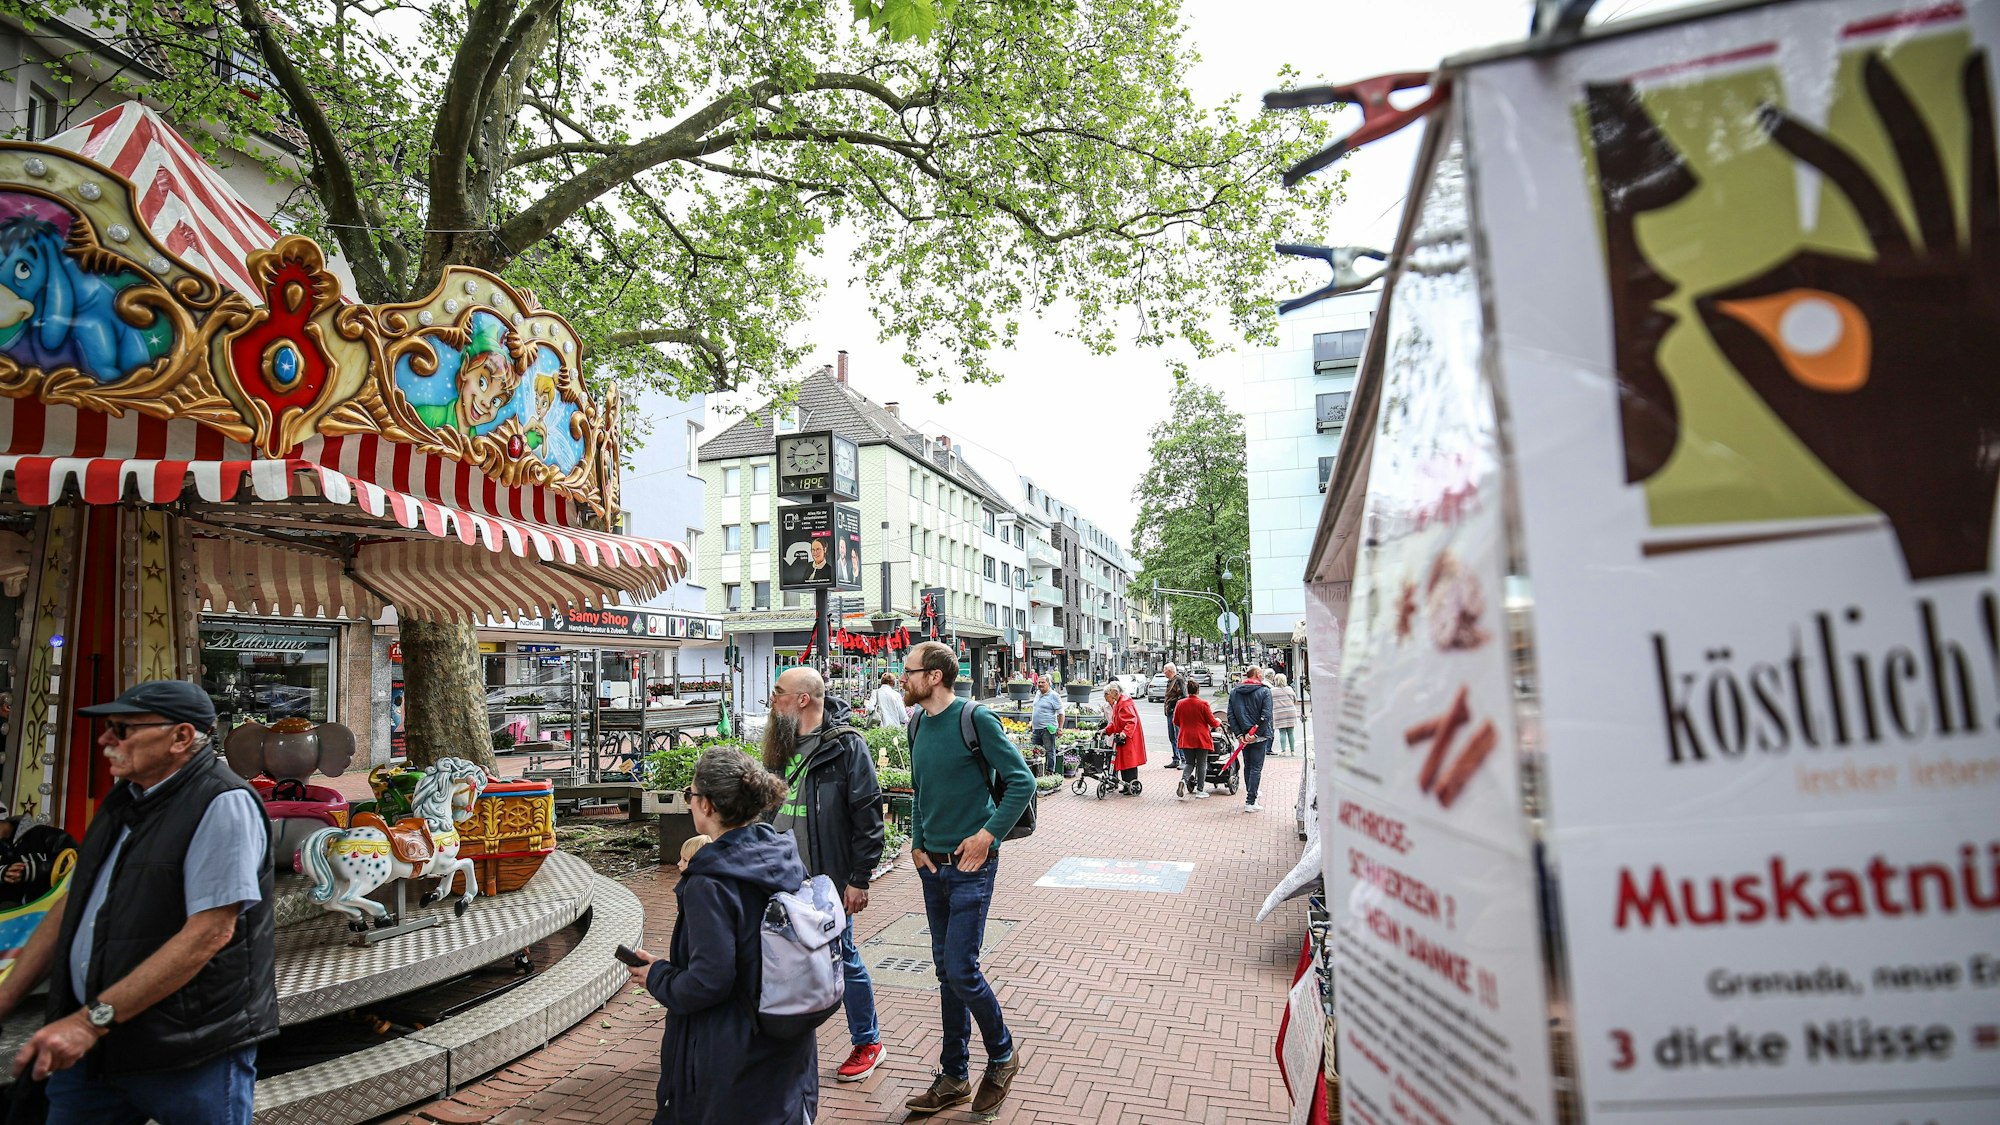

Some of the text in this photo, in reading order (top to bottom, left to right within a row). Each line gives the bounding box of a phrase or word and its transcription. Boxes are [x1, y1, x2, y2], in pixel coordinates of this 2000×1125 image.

[569, 608, 629, 628] Samy Shop
[206, 631, 308, 650] Bellissimo
[1404, 923, 1474, 997] DANKE
[1706, 966, 1864, 998] Grenada,
[1873, 962, 1963, 993] neue
[1608, 1028, 1638, 1072] 3
[1653, 1022, 1789, 1069] dicke
[1804, 1016, 1955, 1064] Nüsse
